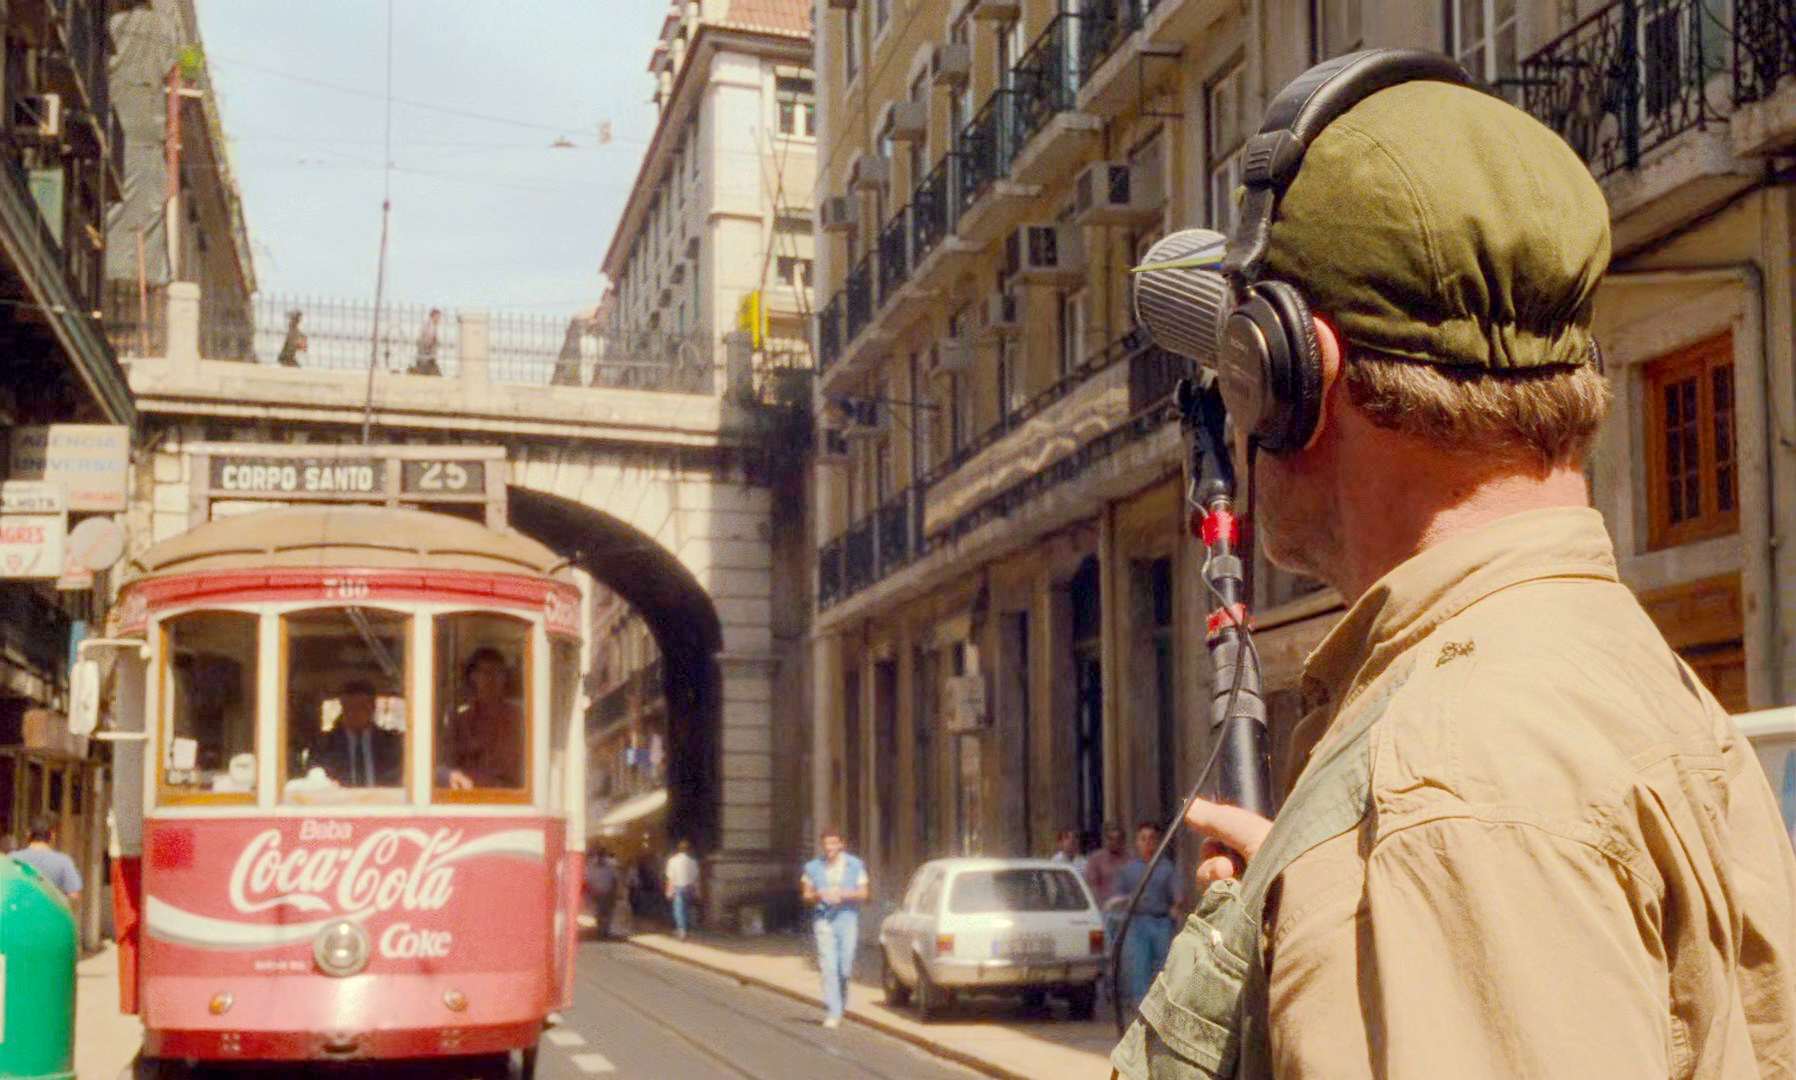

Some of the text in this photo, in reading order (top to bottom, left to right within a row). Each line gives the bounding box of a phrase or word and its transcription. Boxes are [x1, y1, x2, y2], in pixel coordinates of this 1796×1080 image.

[222, 465, 374, 491] CORPO SANTO
[419, 462, 468, 489] 25
[379, 922, 452, 959] Coke
